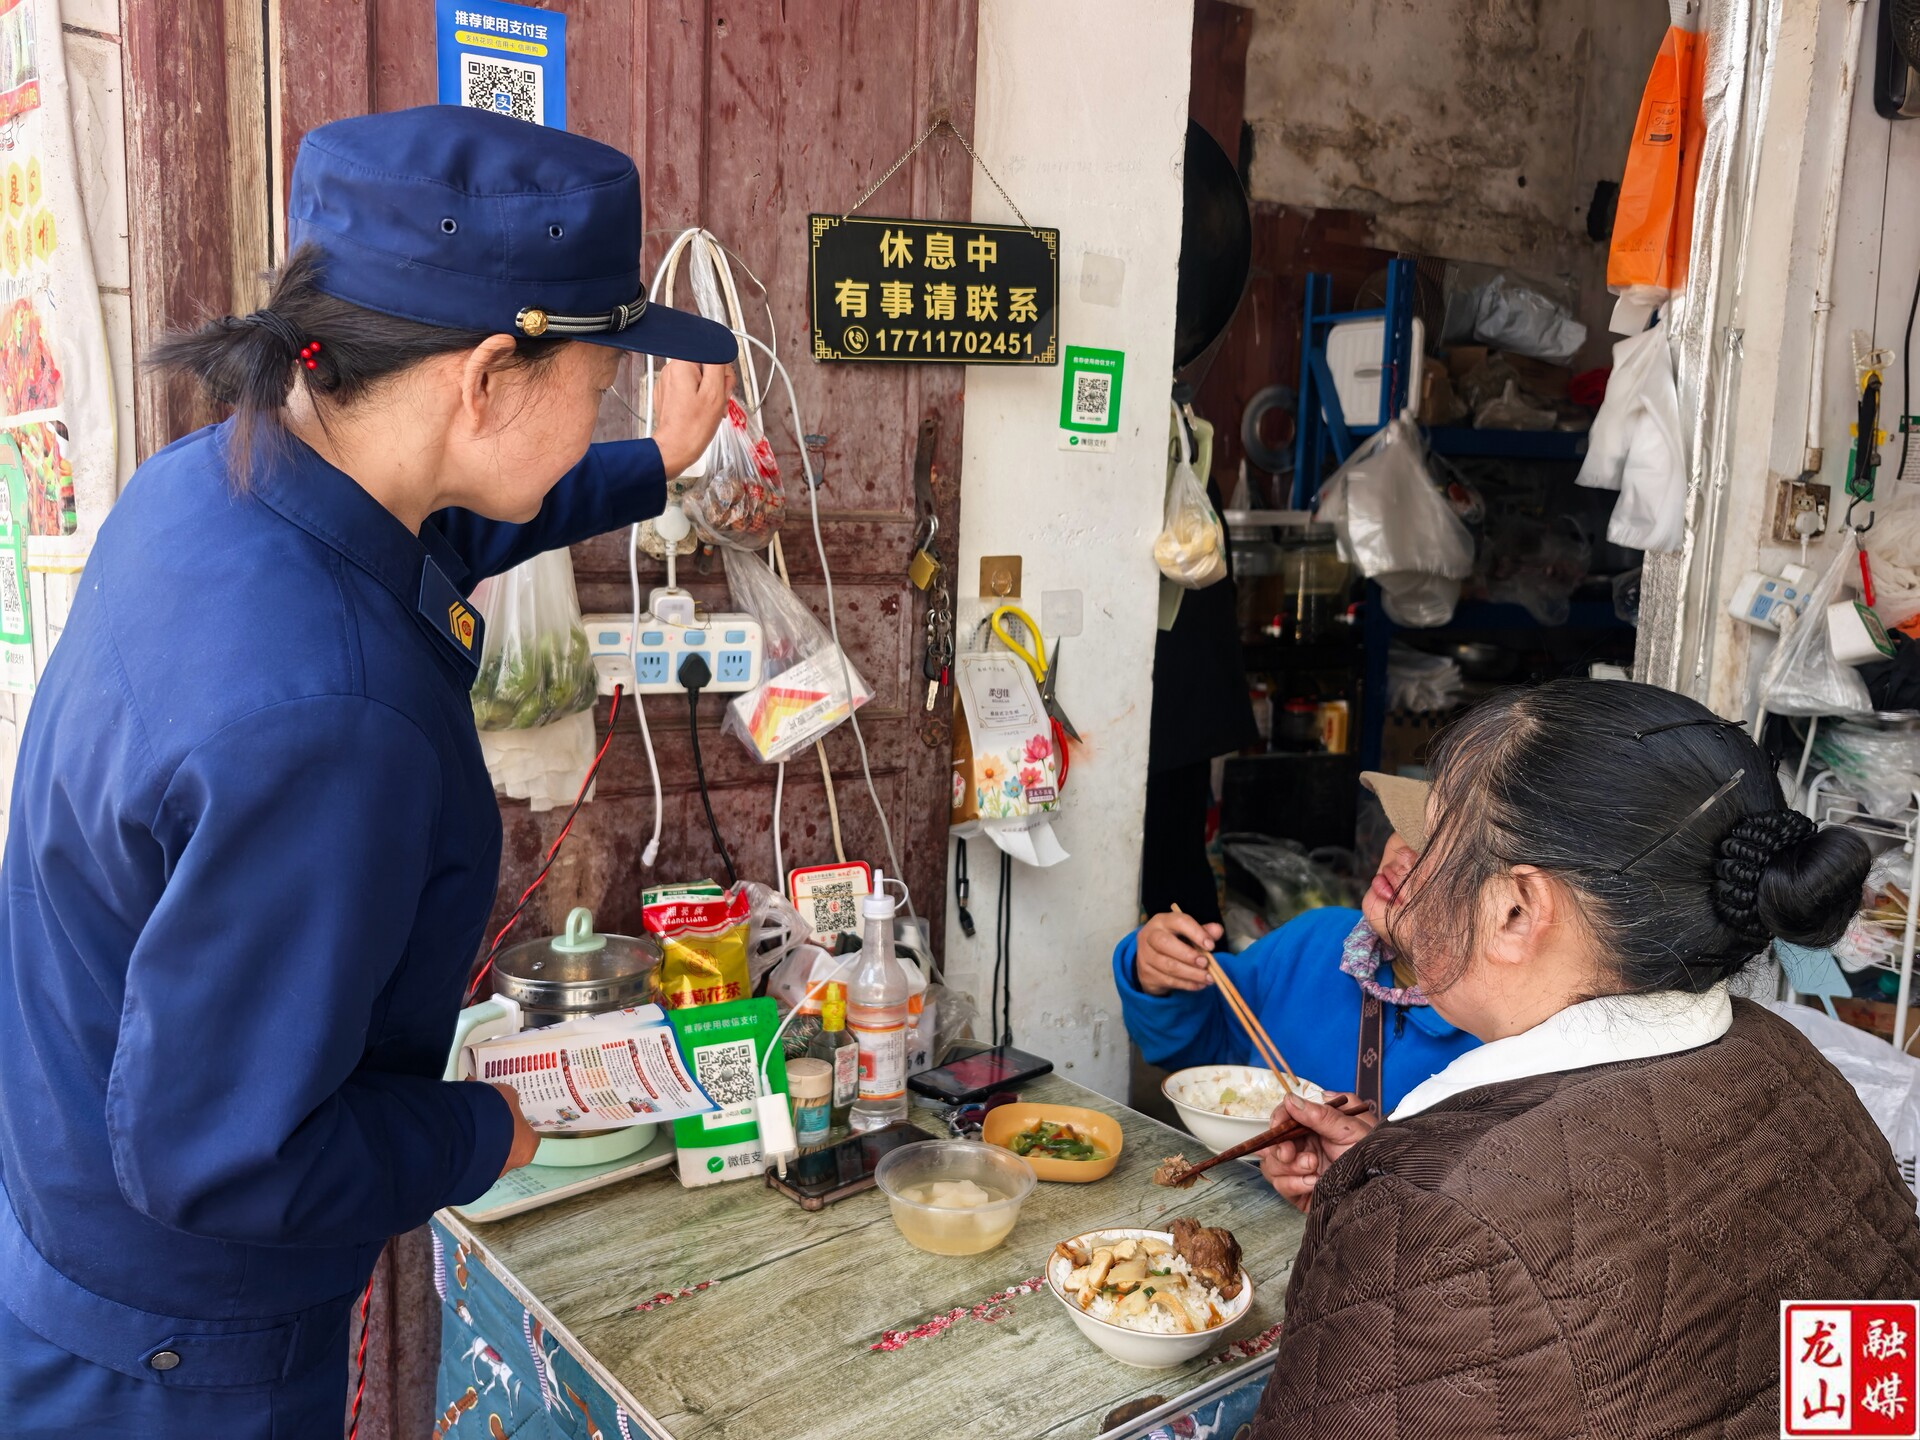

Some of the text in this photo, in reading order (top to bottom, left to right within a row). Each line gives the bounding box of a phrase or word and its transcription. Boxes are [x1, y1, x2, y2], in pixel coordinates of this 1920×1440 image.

[455, 10, 548, 40] 推荐使用支付宝
[879, 229, 998, 273] 休息中
[834, 278, 1039, 323] 有事请联系
[875, 328, 1033, 354] 17711702451
[684, 1014, 758, 1034] 推荐使用微信支付
[727, 1151, 763, 1168] 微信支
